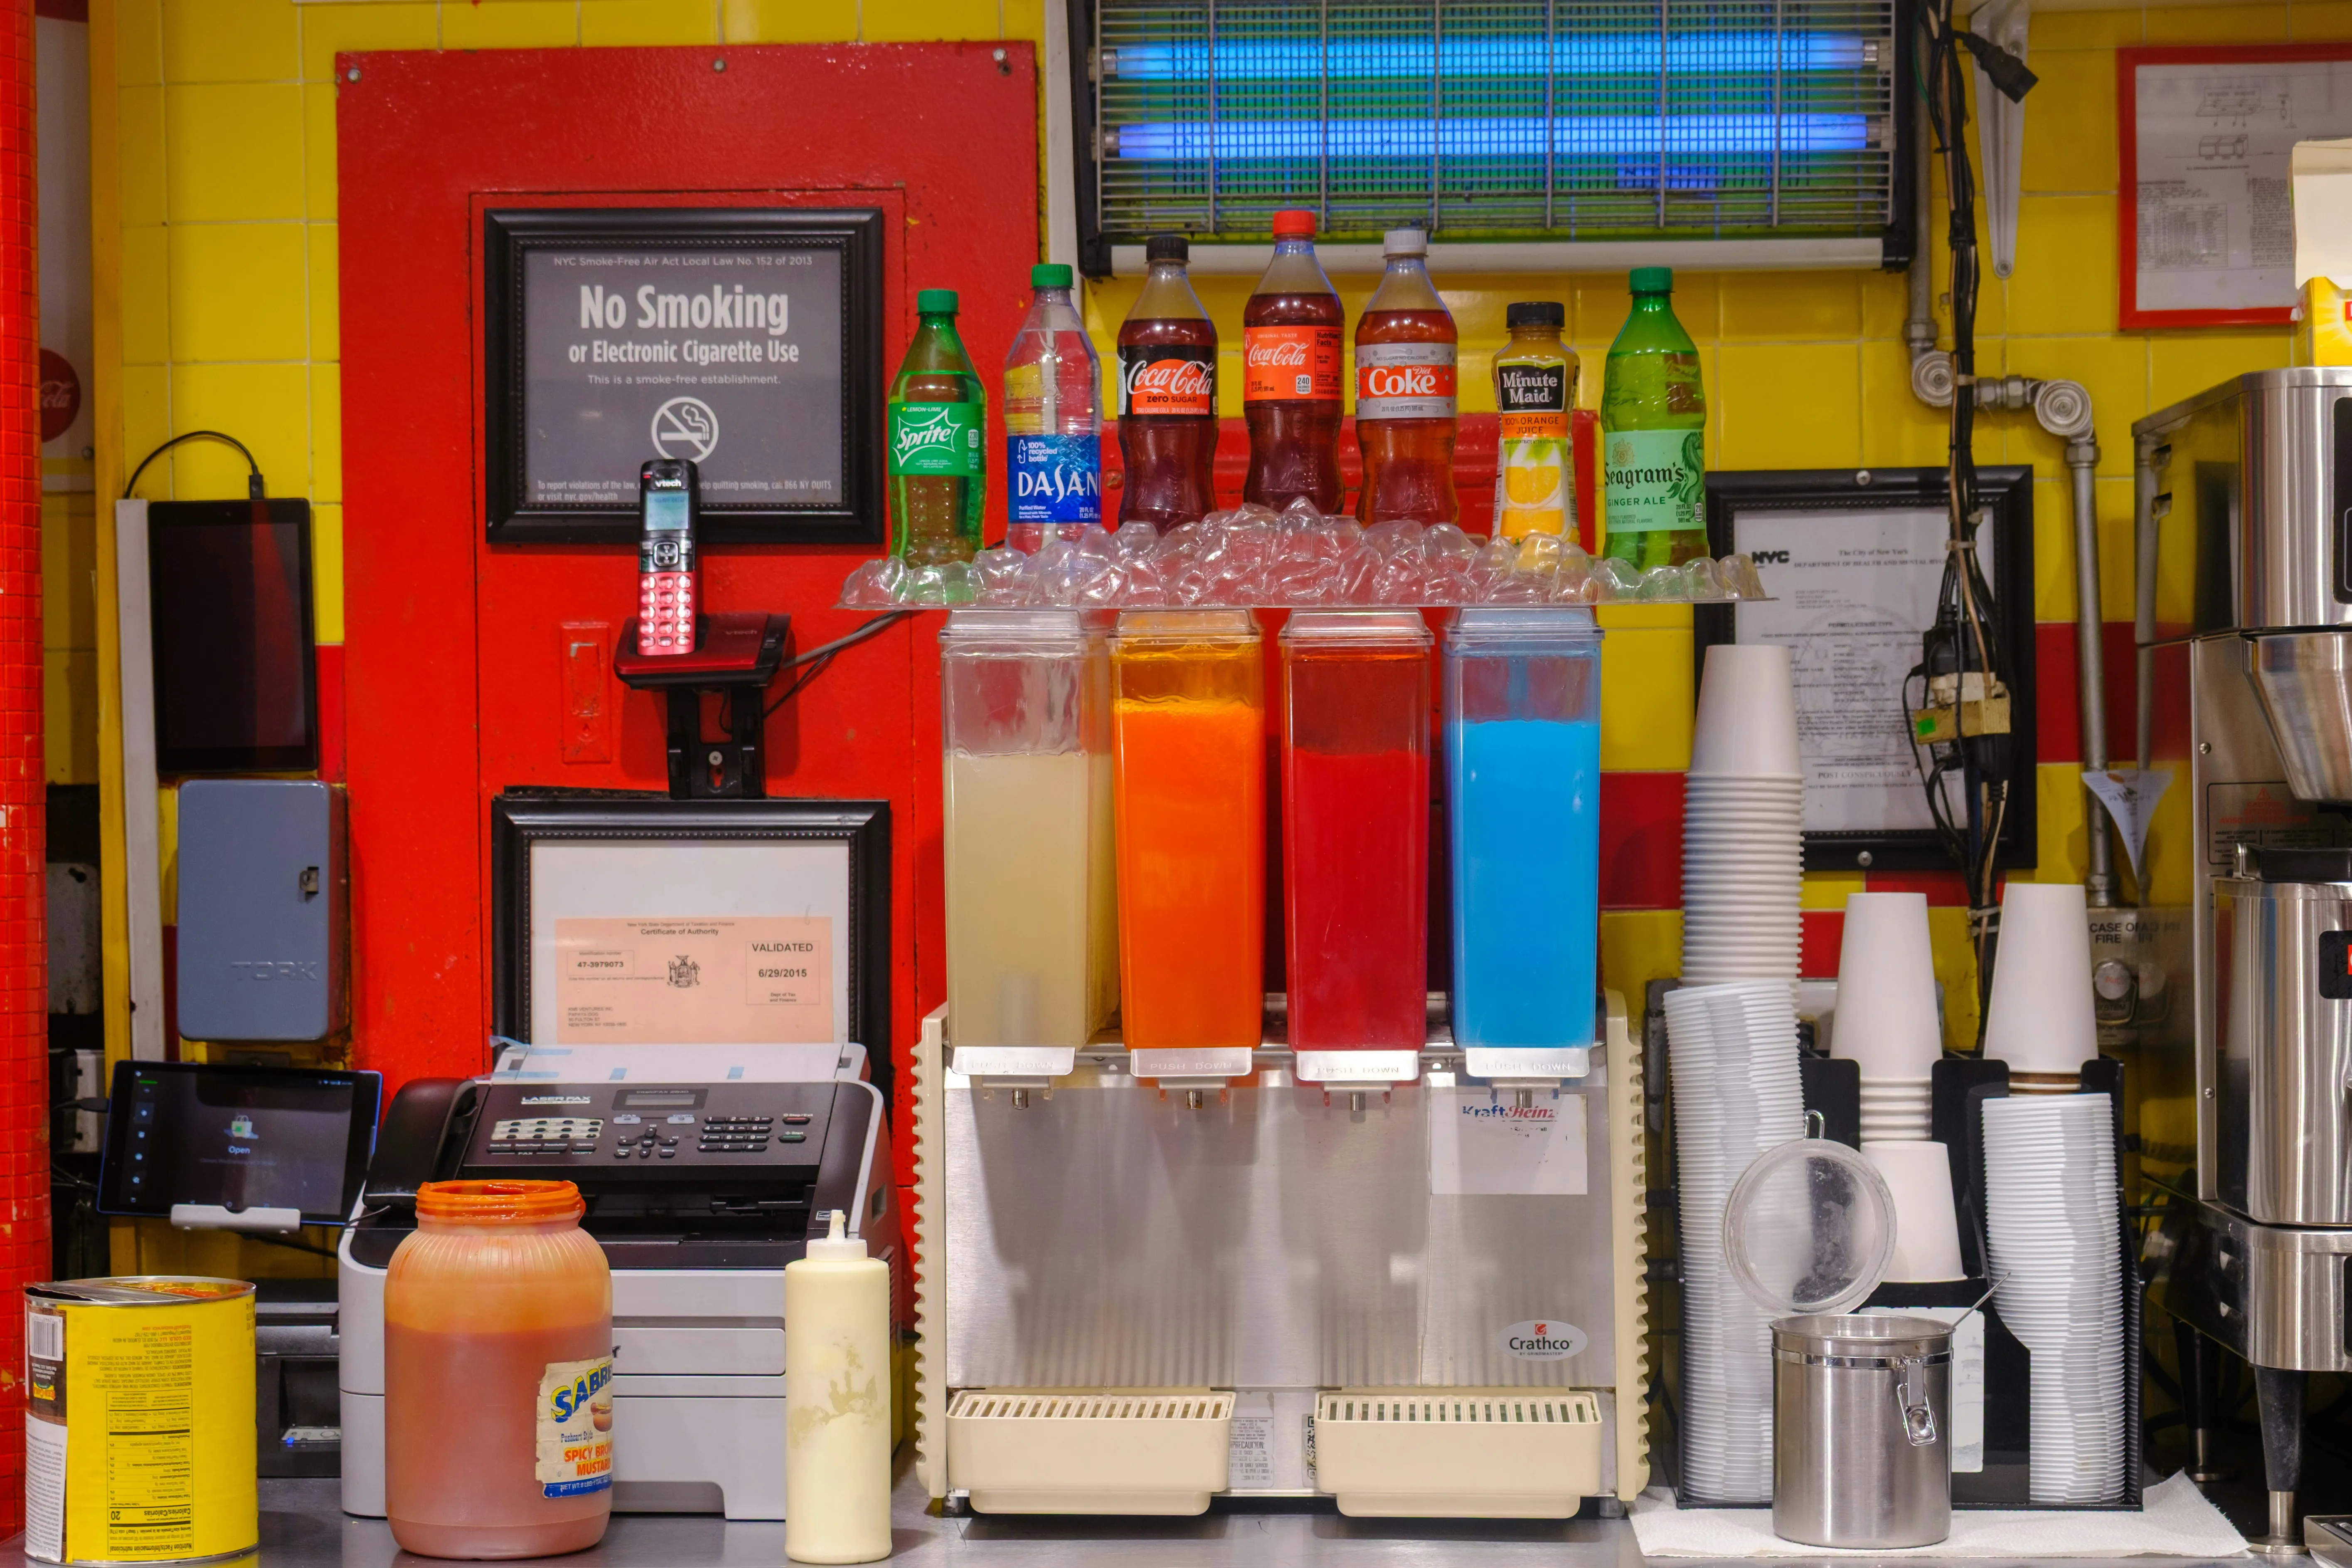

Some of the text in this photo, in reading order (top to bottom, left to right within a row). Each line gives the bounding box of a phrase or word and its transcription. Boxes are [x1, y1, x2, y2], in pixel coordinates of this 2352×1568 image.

[554, 257, 813, 266] NYC Smoke-Free Air Act Local Law No. 152 of 2013
[580, 284, 788, 335] No Smoking
[569, 340, 799, 366] or Electronic Cigarette Use
[1249, 342, 1310, 367] Coca-Cola
[1413, 366, 1431, 374] Diet
[588, 375, 611, 384] This
[613, 375, 623, 384] is
[636, 375, 698, 384] smoke-free
[701, 375, 781, 384] establishment.
[1127, 360, 1215, 396] Coca-Cola
[1369, 368, 1436, 395] Coke
[1502, 372, 1558, 388] Minute
[1509, 388, 1549, 403] Maid
[897, 424, 951, 451] Sprite
[547, 481, 568, 491] report
[569, 480, 601, 490] violations
[602, 480, 609, 490] of
[611, 480, 622, 490] the
[623, 480, 637, 491] law,
[698, 480, 711, 490] elp
[713, 480, 739, 491] quitting
[740, 480, 770, 491] smoking,
[785, 480, 797, 490] 866
[800, 480, 810, 490] NY
[655, 479, 682, 487] vtech
[1018, 464, 1101, 503] DASANI
[564, 492, 618, 502] nyc.gov/health
[1608, 498, 1640, 507] GINGER
[1752, 551, 1790, 564] NYC
[2090, 923, 2122, 933] CASE
[2096, 934, 2121, 943] FIRE
[752, 943, 813, 952] VALIDATED
[759, 969, 807, 977] 6/29/2015
[228, 1145, 250, 1155] Open
[1509, 1337, 1569, 1350] Crathco
[561, 1433, 582, 1442] Pushcart
[564, 1445, 593, 1462] SPICY
[576, 1458, 610, 1476] MUSTARD
[111, 1511, 120, 1520] 20
